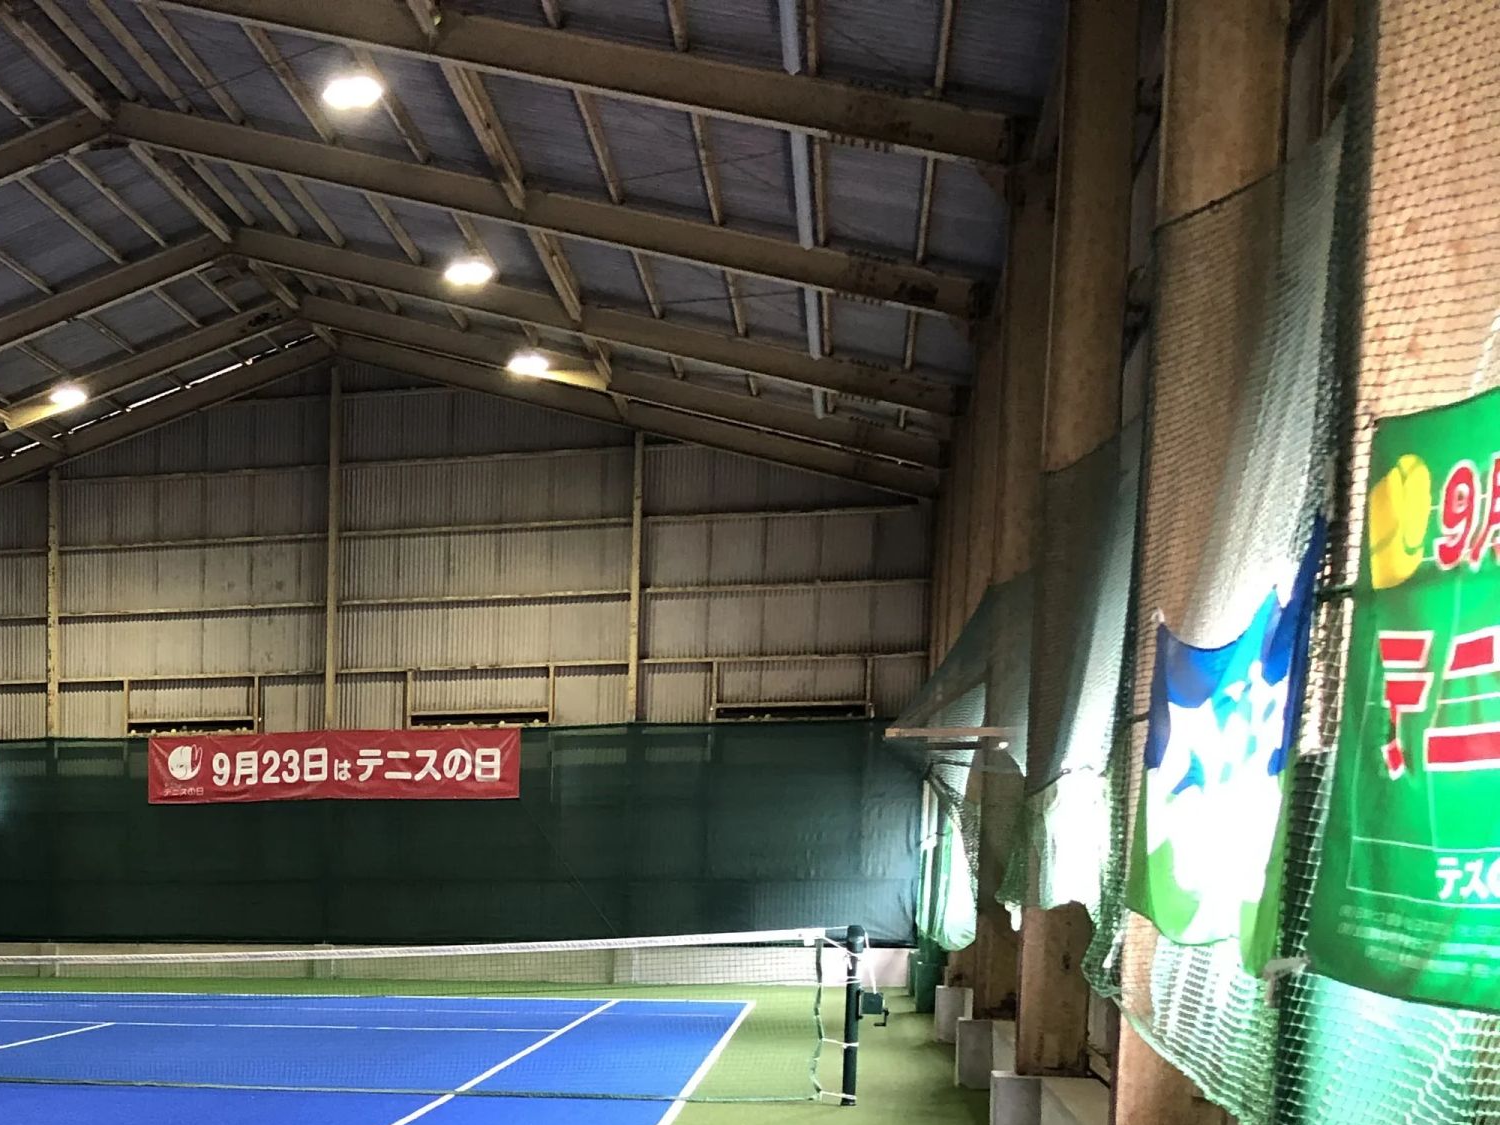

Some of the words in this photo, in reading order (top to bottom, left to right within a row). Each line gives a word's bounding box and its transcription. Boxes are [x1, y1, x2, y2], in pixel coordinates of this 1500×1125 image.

[211, 747, 502, 786] 9月23日はテニスの日
[163, 787, 204, 797] テニスの日
